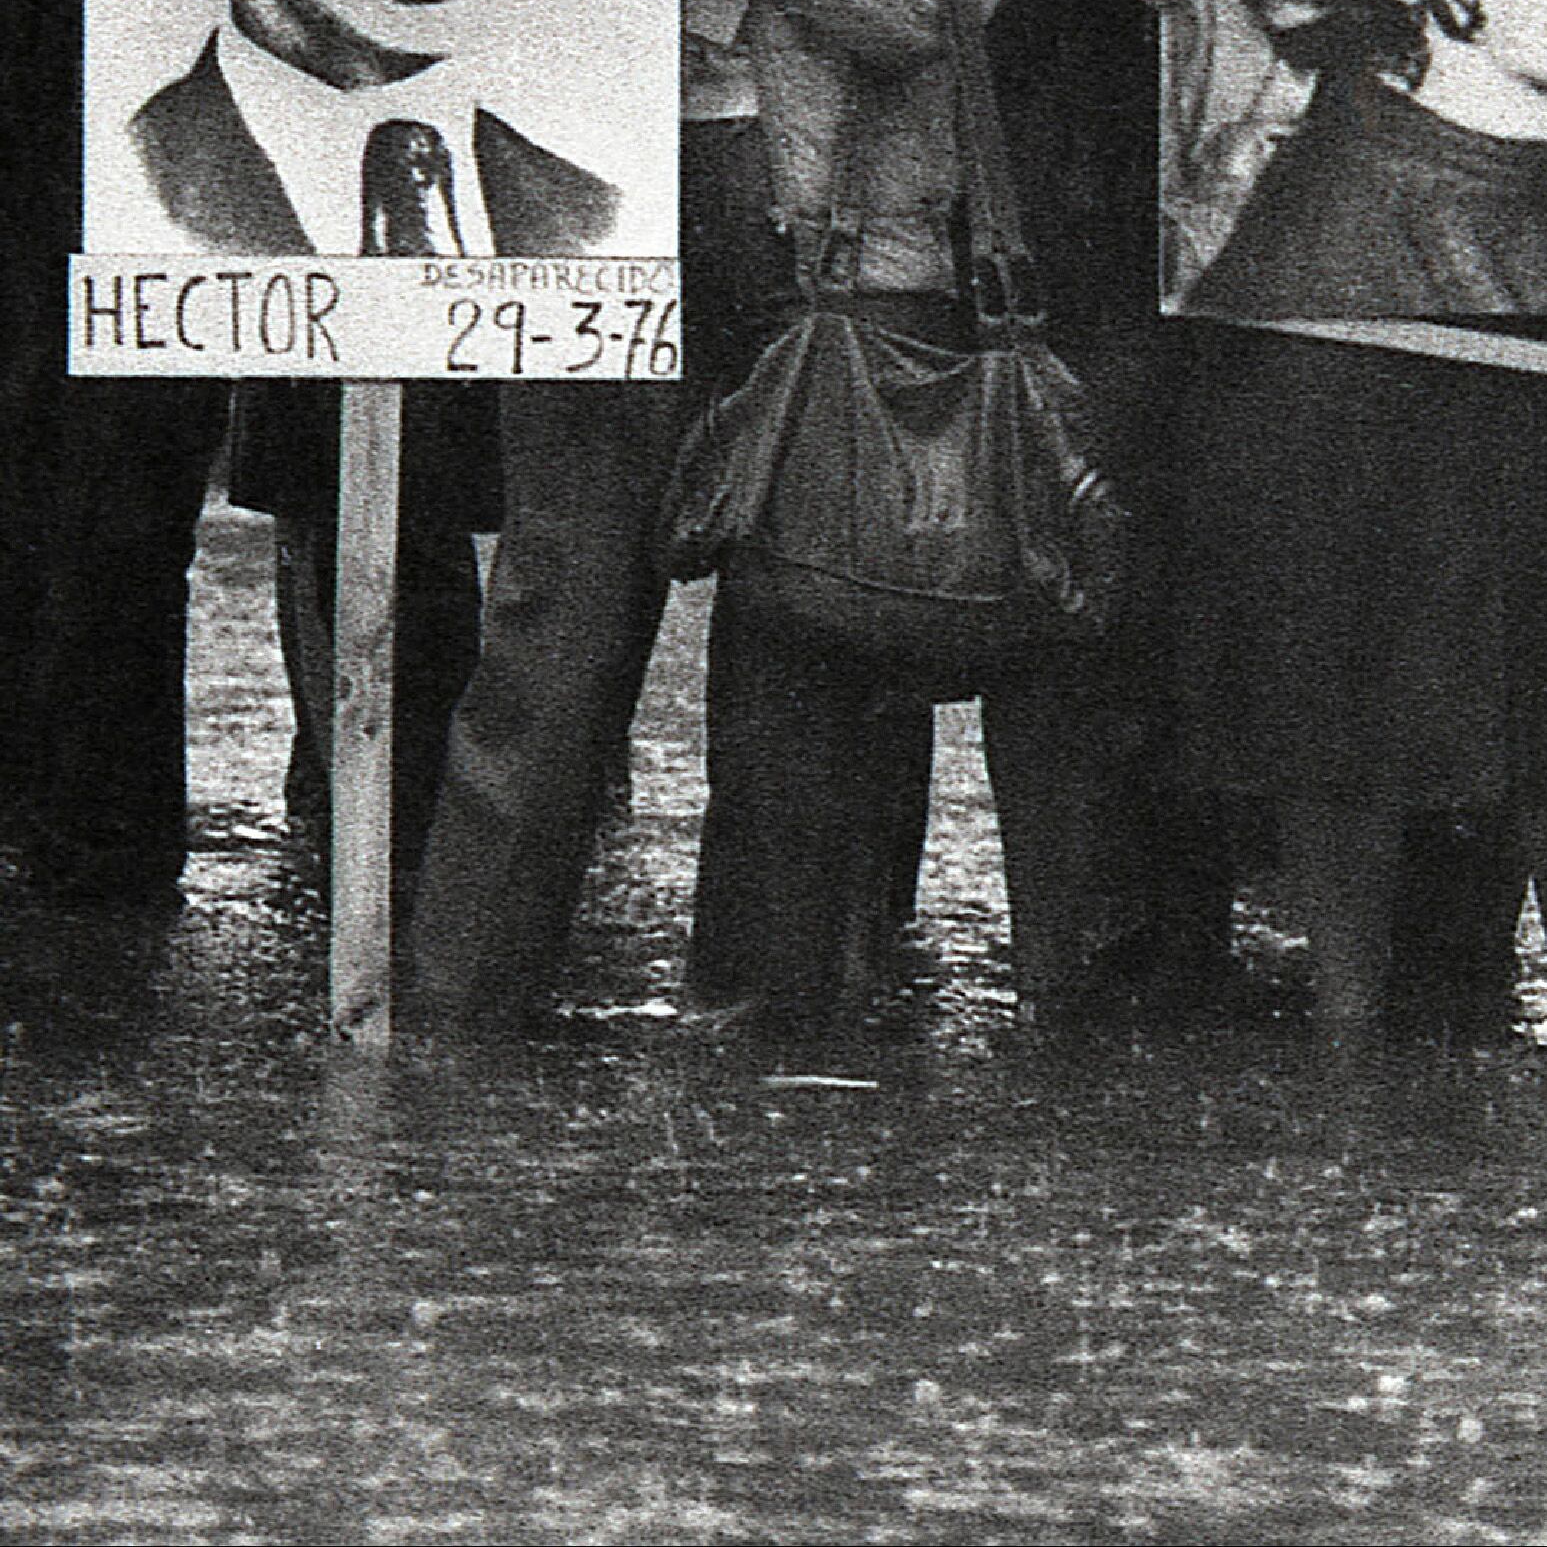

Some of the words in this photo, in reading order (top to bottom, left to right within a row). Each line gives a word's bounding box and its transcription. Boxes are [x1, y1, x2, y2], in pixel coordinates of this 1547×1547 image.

[421, 261, 677, 297] DESAPARECIDO
[84, 273, 340, 362] HECTOR
[446, 297, 681, 381] 29-3-76
